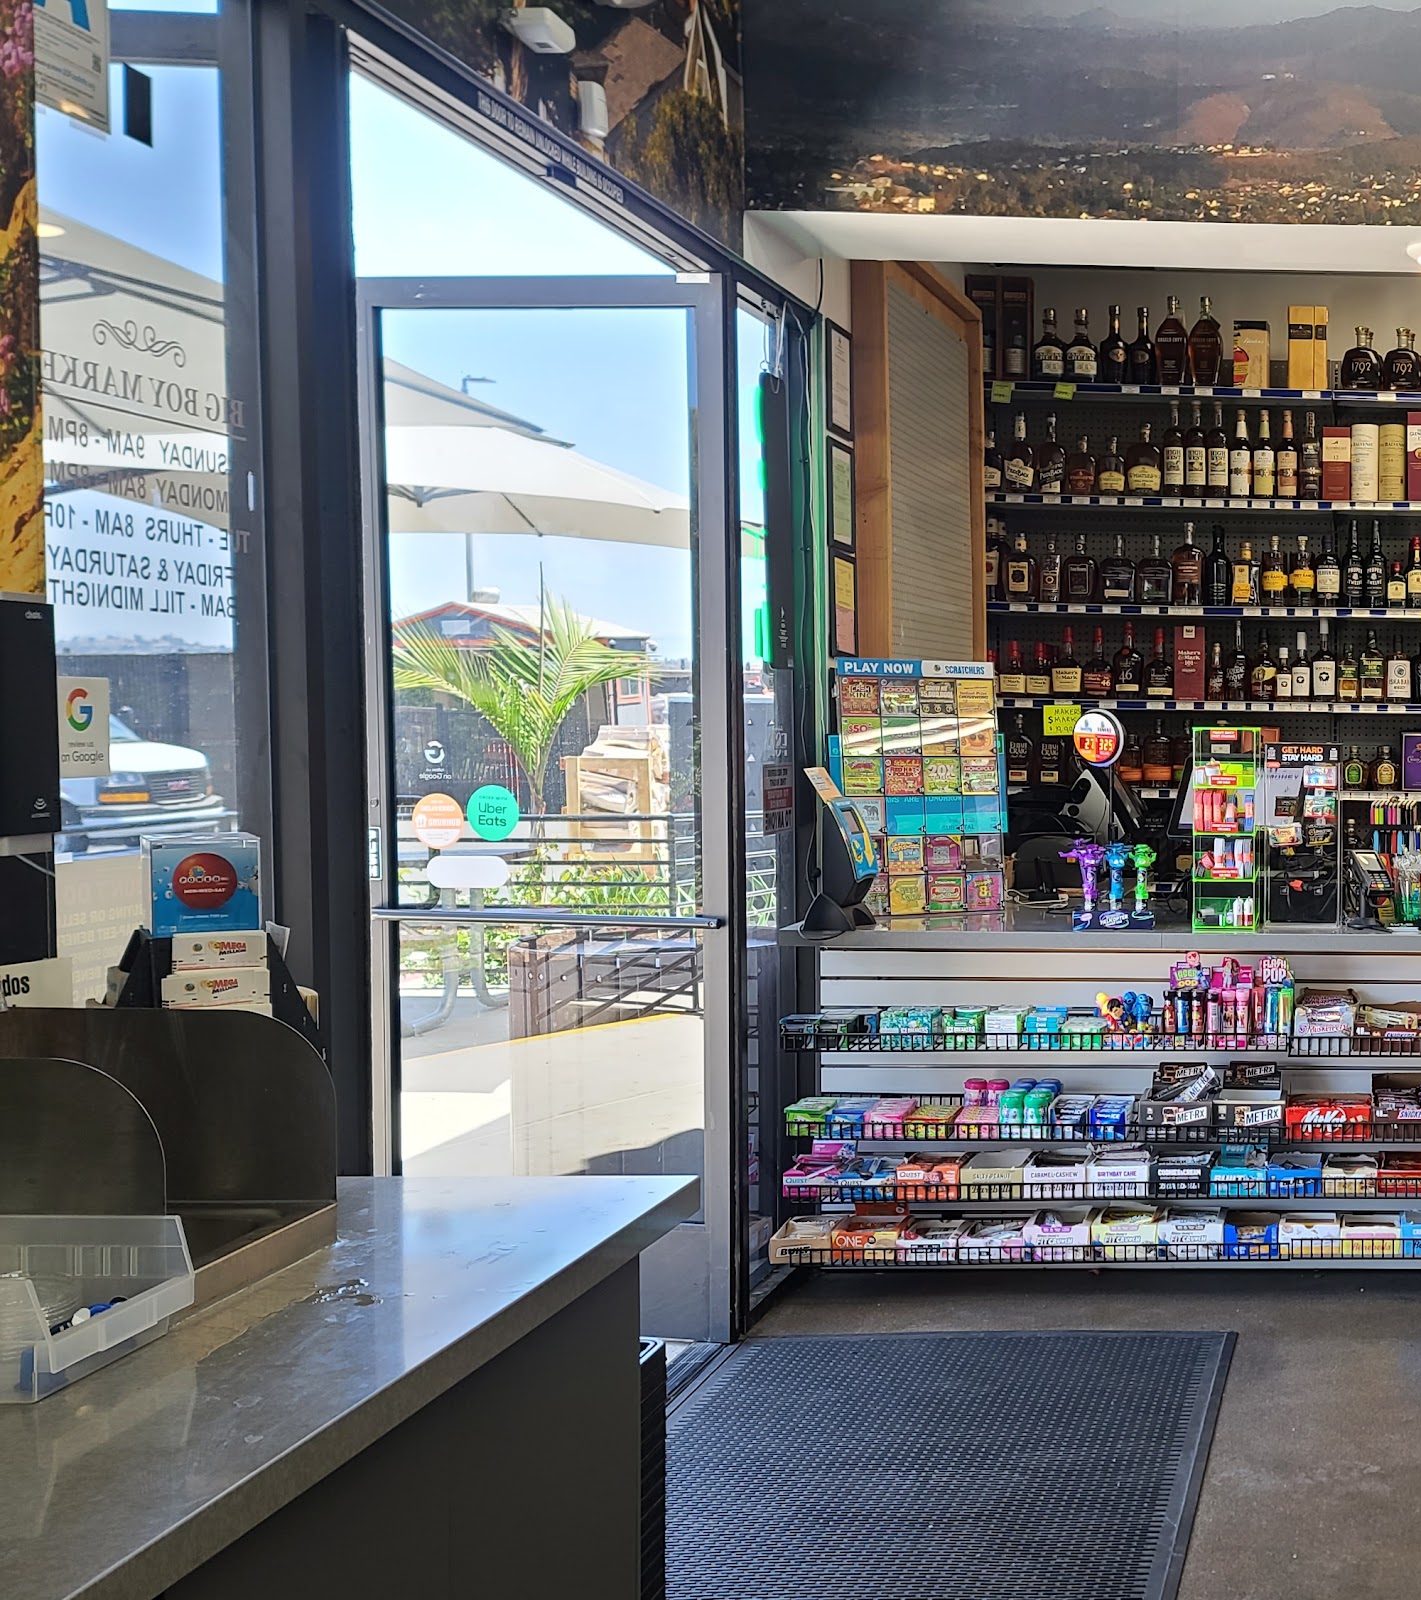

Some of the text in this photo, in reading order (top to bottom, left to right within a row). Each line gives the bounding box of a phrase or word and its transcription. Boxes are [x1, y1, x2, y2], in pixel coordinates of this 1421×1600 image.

[1351, 362, 1371, 375] 1792
[1392, 363, 1413, 375] 1792
[844, 662, 879, 673] PLAY
[883, 663, 914, 674] NOW
[1119, 670, 1133, 683] 46
[72, 751, 104, 764] Google
[478, 802, 508, 814] Uber
[478, 815, 508, 827] Eats
[220, 941, 247, 951] MEGA
[1262, 960, 1287, 969] FLASH
[1262, 968, 1287, 983] POP
[213, 979, 239, 988] MEGA
[899, 1171, 922, 1179] QUEST
[835, 1235, 863, 1247] ONE
